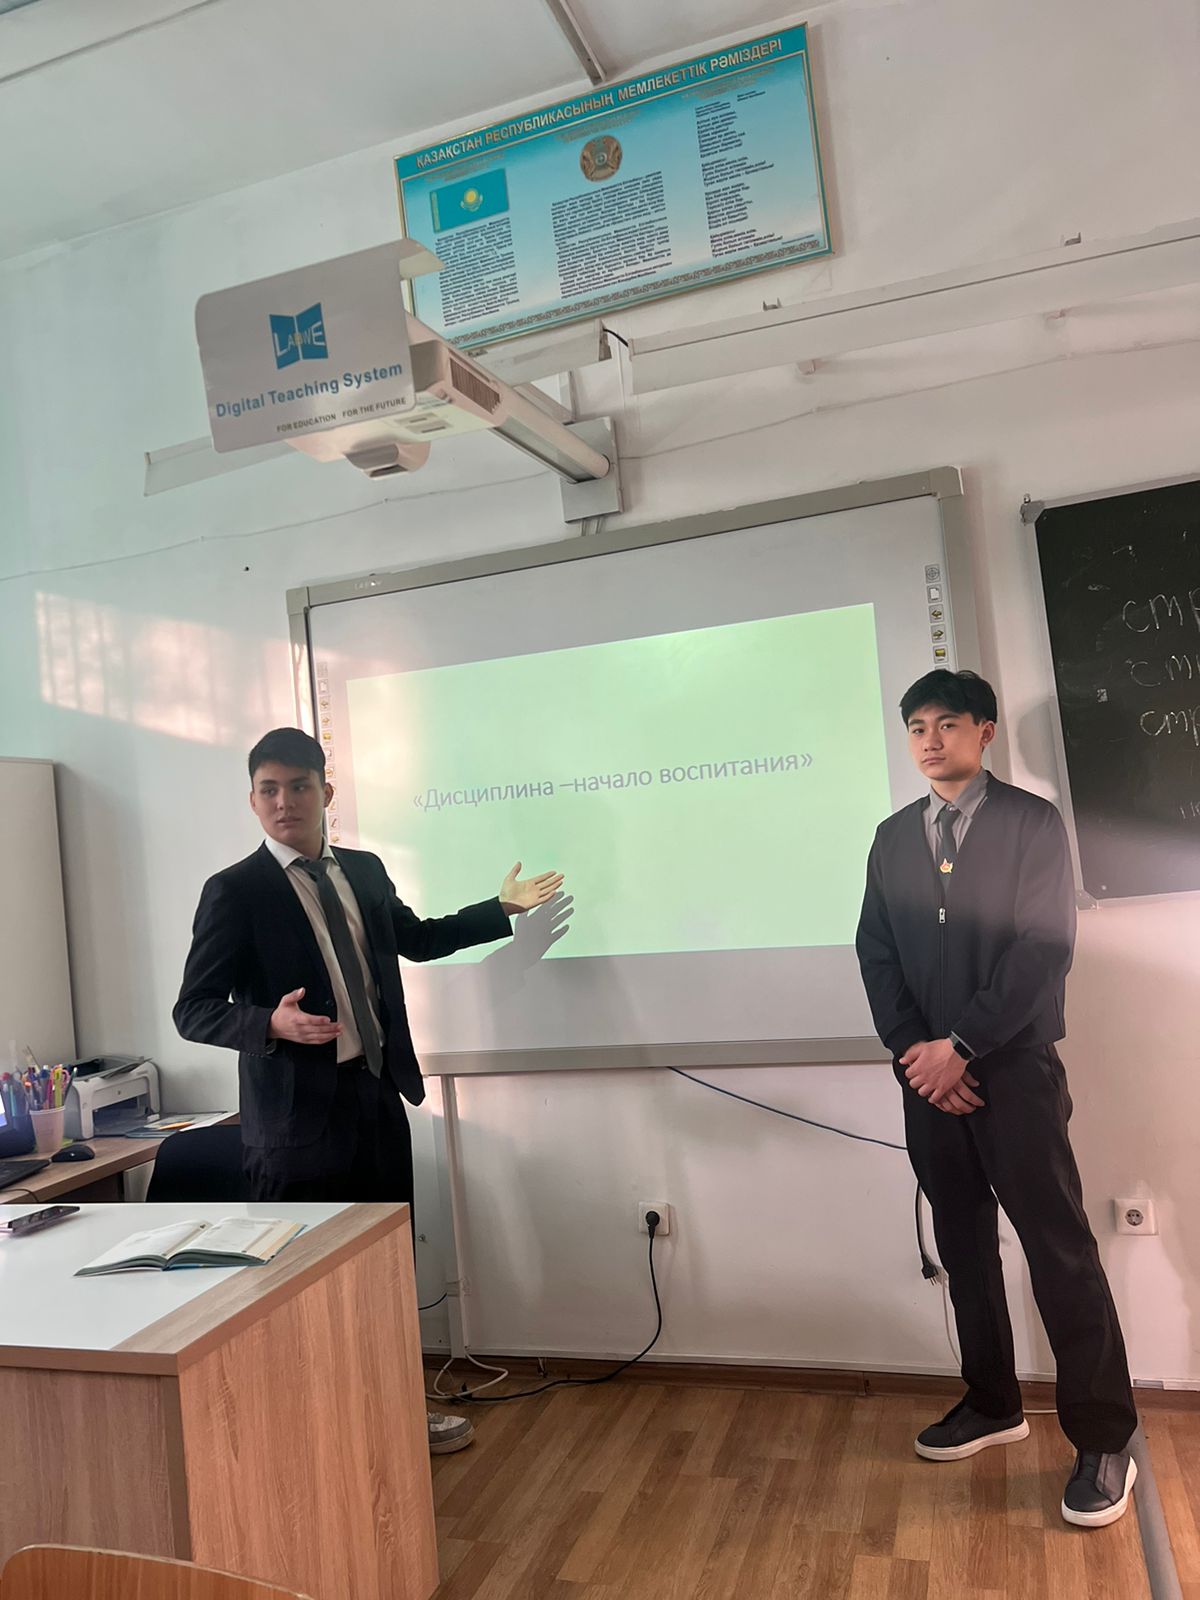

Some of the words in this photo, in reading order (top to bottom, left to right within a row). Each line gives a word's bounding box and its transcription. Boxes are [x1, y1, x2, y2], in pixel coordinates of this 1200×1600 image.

[416, 135, 483, 169] ҚАЗАҚСТАН
[485, 92, 614, 145] РЕСПУБЛИКАСЫНЫҢ
[618, 62, 708, 102] МЕМЛЕКЕТТІК
[710, 38, 782, 72] РӘМІЗДЕРІ
[216, 393, 265, 418] Digital
[268, 378, 339, 405] Teaching
[343, 363, 402, 389] System
[277, 422, 292, 433] FOR
[293, 413, 336, 430] EDUCATION
[342, 408, 358, 419] FOR
[359, 405, 375, 415] THE
[375, 397, 406, 411] FUTURE
[412, 780, 554, 812] «Дисциплина
[659, 752, 813, 785] воспитания»
